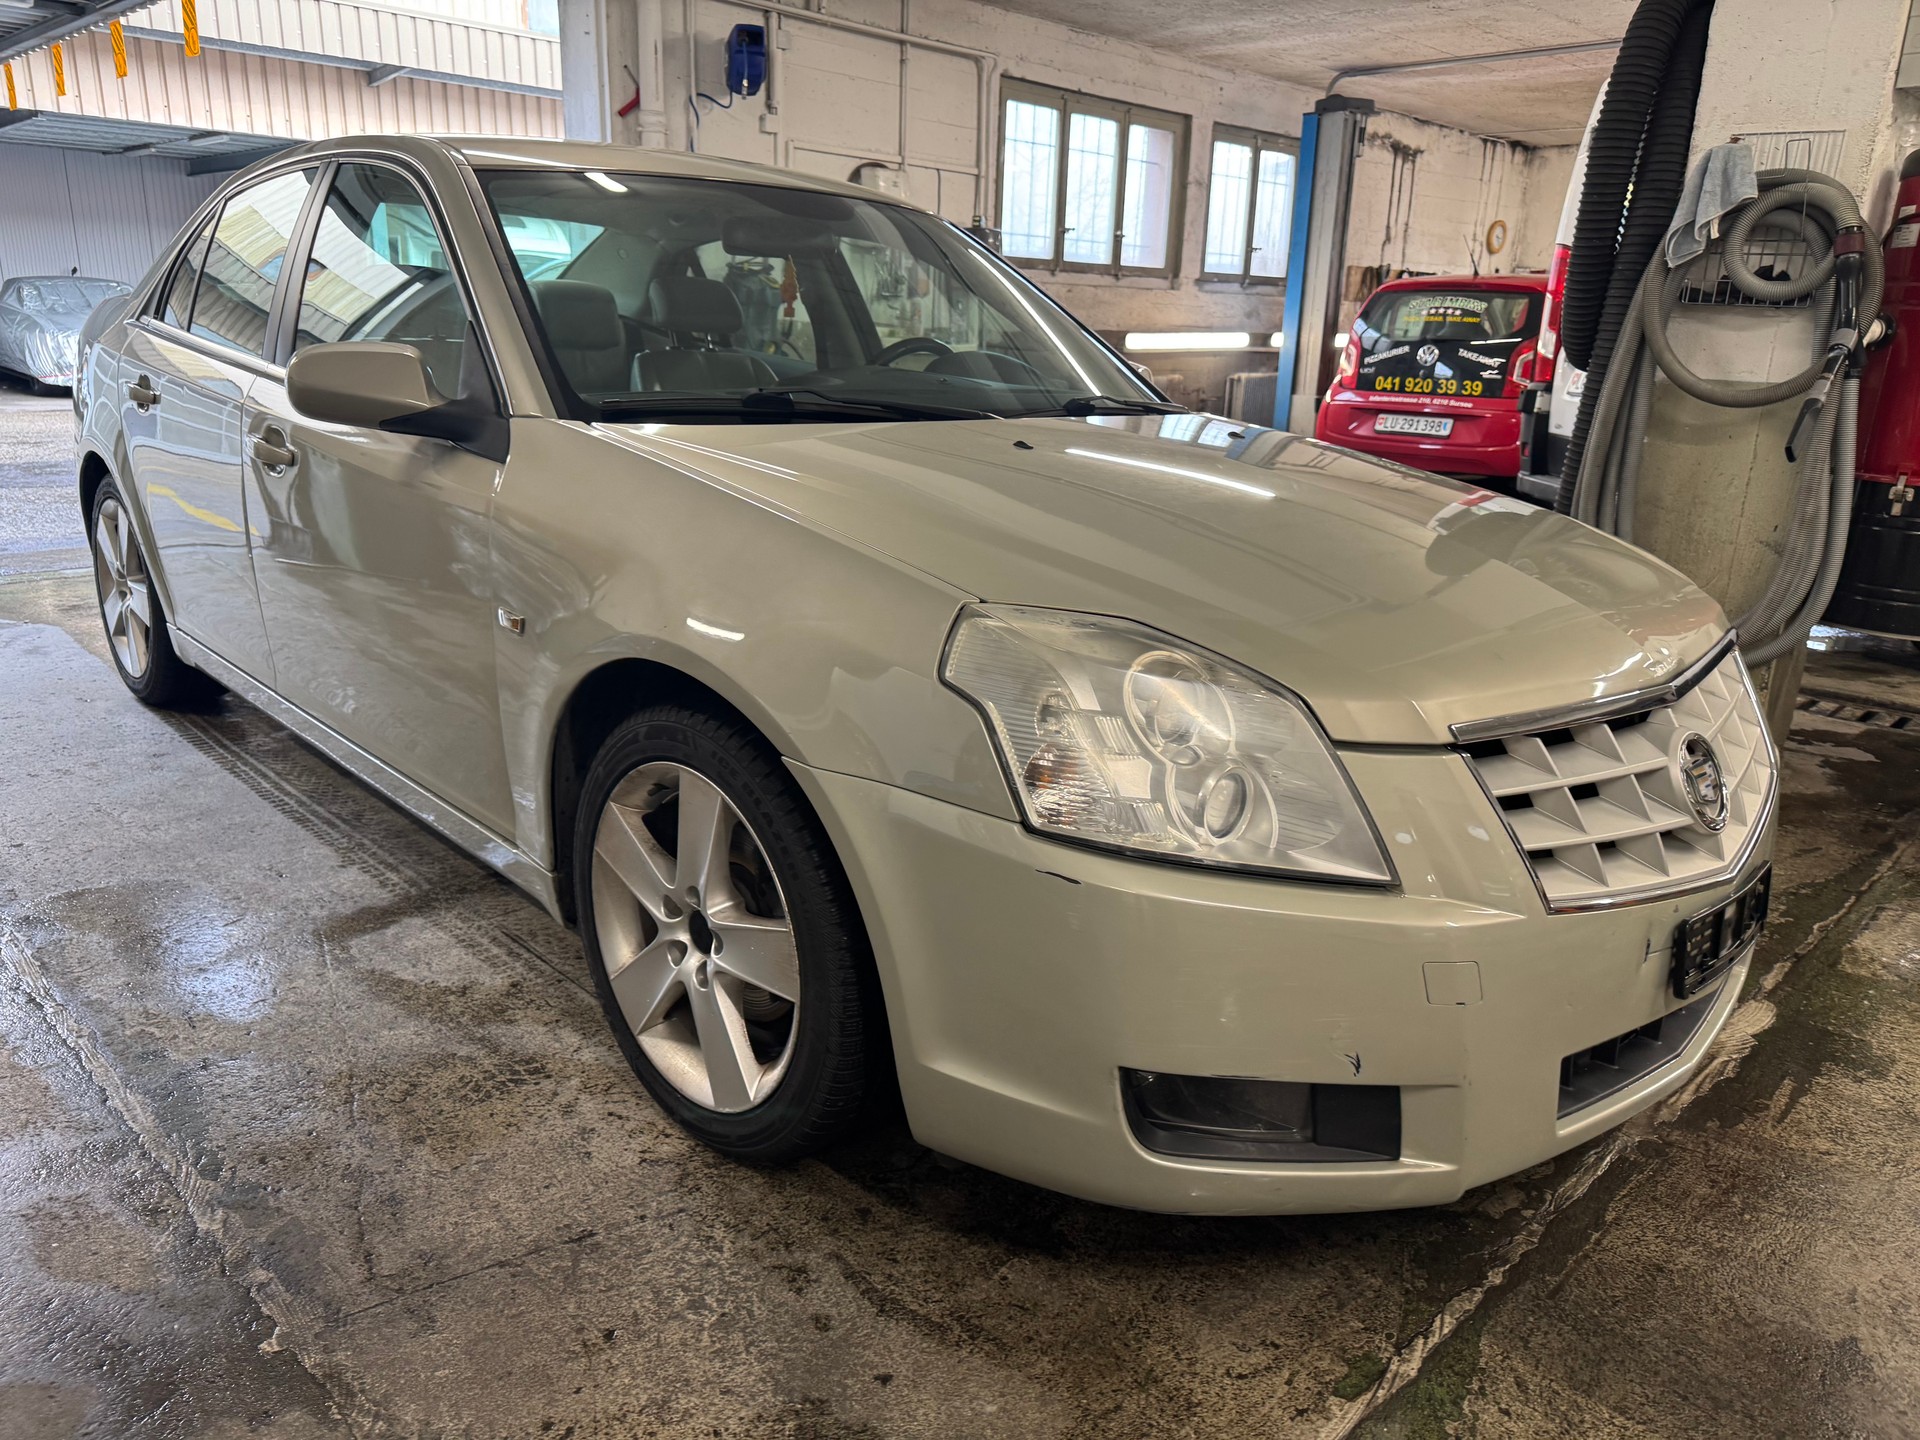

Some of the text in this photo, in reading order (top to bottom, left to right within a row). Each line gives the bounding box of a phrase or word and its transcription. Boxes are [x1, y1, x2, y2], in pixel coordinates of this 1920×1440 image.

[1363, 345, 1410, 365] PIZZAKURIER
[1457, 348, 1502, 368] TAKEAWAY
[1375, 376, 1483, 396] 041 920 39 39
[1449, 399, 1474, 408] Sursee
